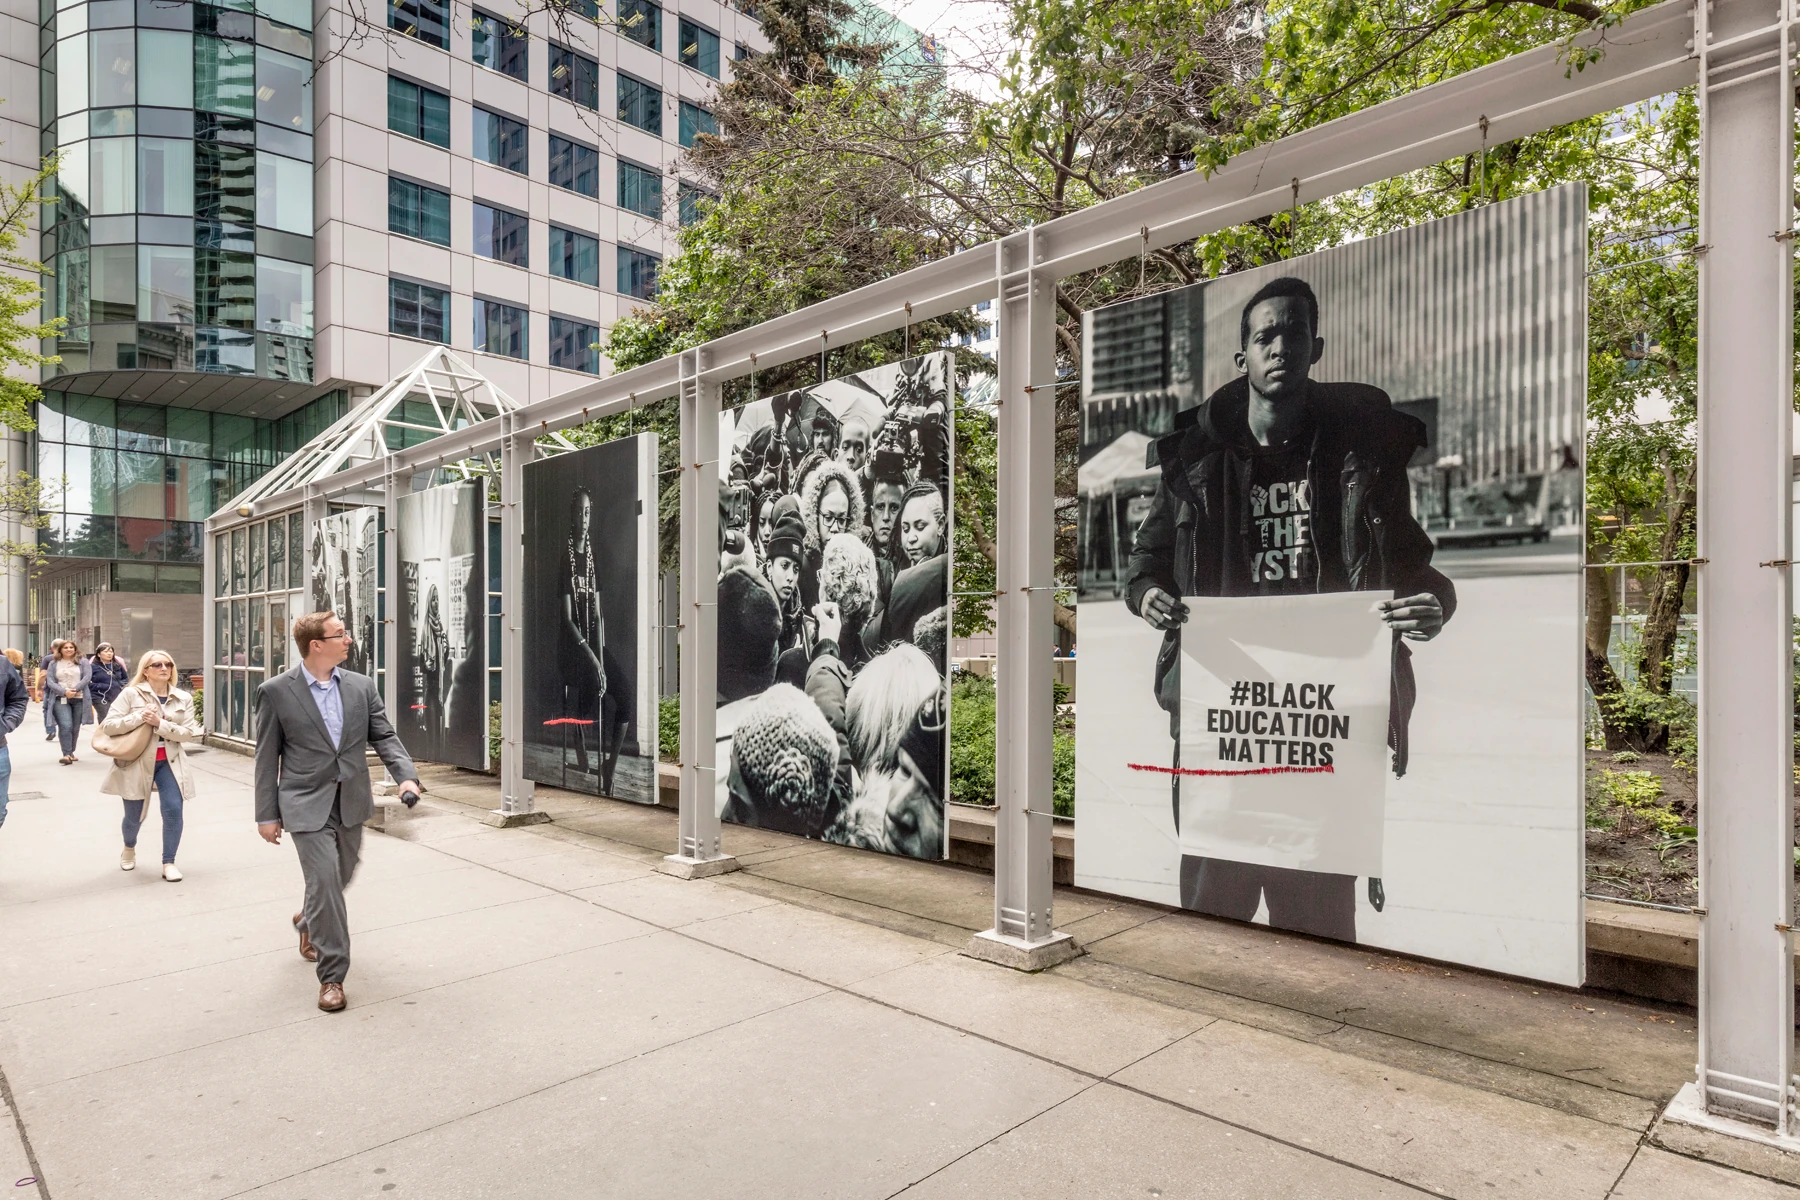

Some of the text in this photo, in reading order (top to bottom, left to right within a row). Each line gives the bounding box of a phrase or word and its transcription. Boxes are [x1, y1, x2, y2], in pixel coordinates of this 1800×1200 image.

[1255, 514, 1310, 548] THE
[1230, 681, 1335, 711] #BLACK
[1207, 708, 1350, 740] EDUCATION
[1219, 737, 1334, 768] MATTERS
